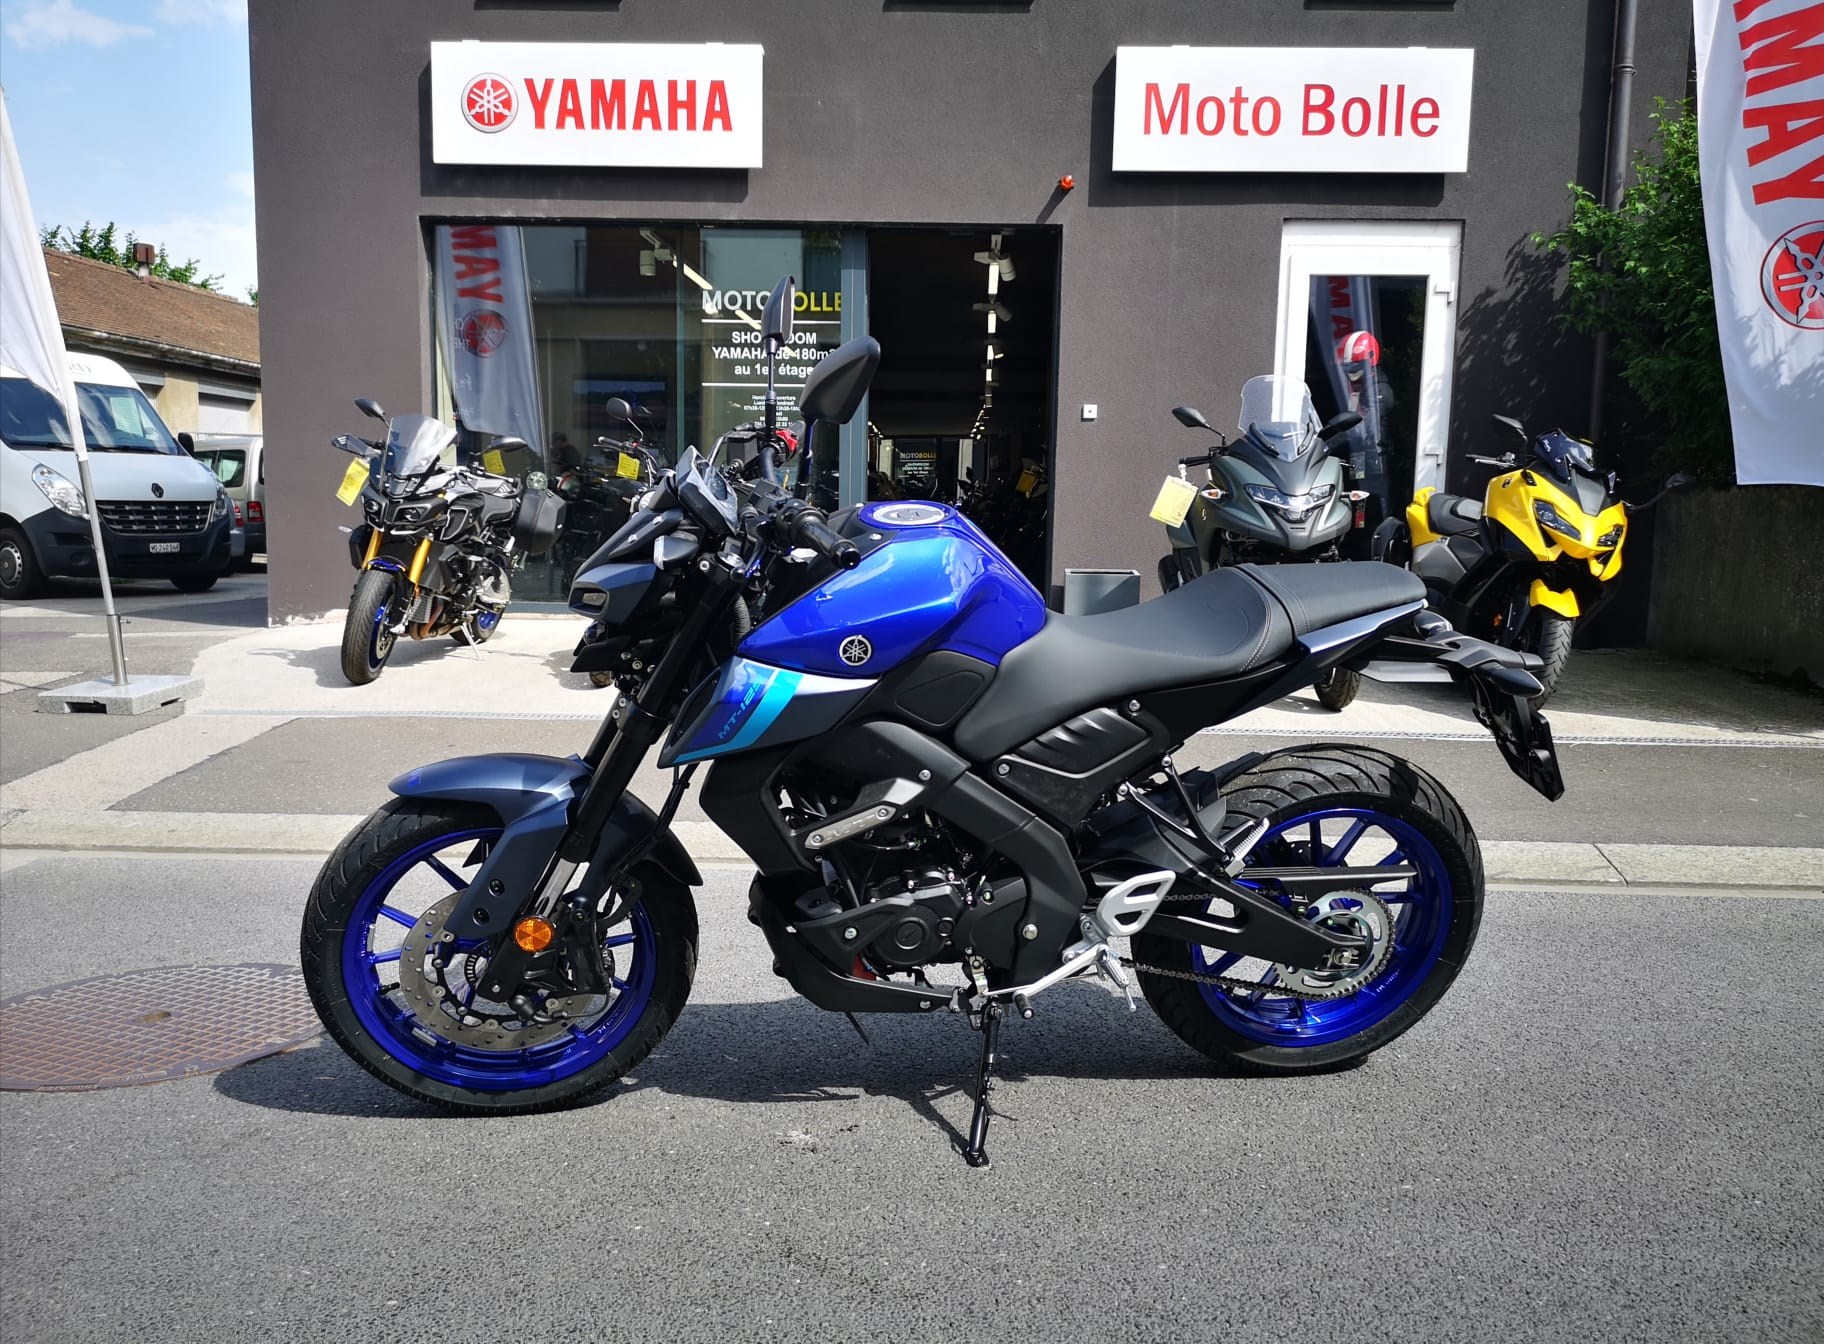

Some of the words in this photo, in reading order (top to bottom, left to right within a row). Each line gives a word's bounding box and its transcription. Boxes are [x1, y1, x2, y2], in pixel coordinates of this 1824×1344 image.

[523, 78, 733, 132] YAMAHA
[1142, 82, 1282, 137] Moto
[1301, 83, 1440, 137] Bolle
[702, 290, 842, 312] MOTOOLLE
[775, 347, 789, 360] de
[734, 366, 751, 375] au
